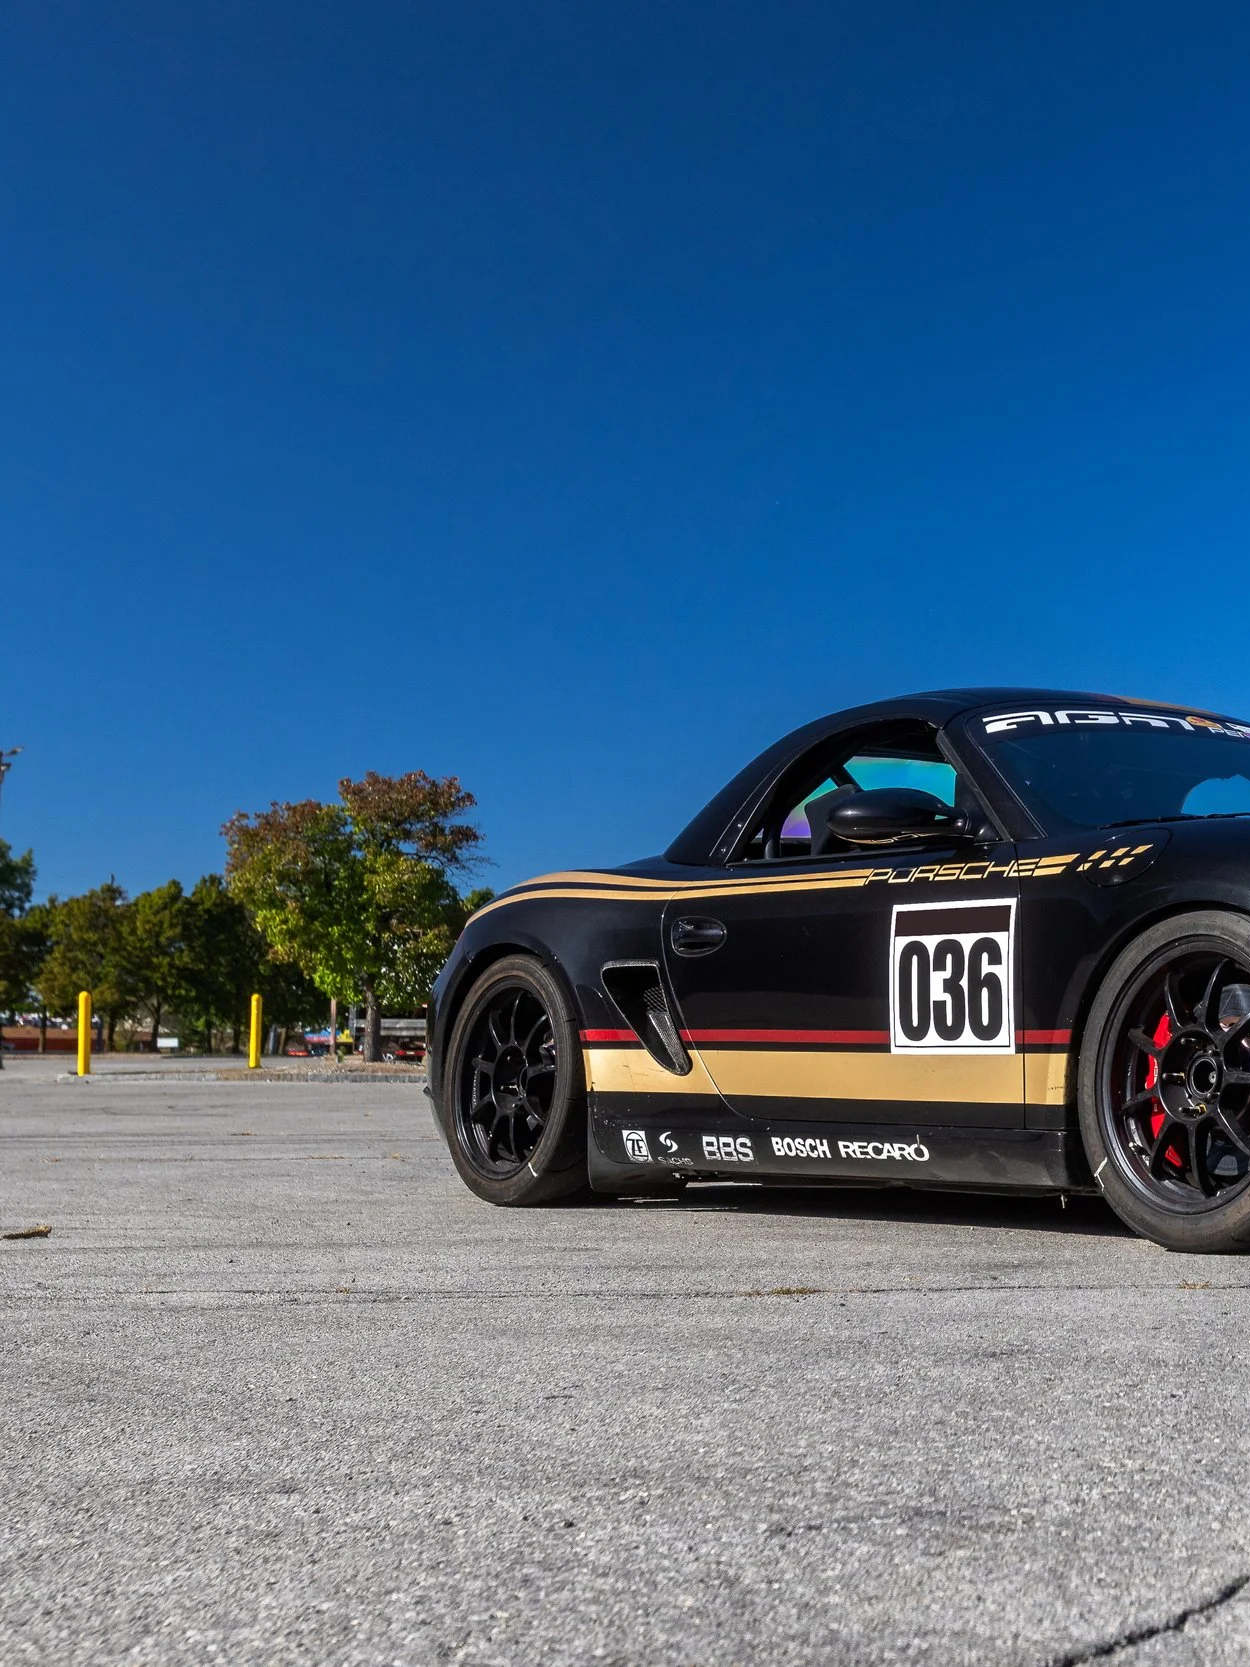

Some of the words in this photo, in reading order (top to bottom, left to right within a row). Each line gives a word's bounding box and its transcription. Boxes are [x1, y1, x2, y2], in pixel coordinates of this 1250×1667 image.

[864, 859, 1037, 885] PORSCHE
[898, 936, 1003, 1042] 036
[702, 1135, 754, 1162] BBS
[771, 1136, 832, 1159] BOSCH
[838, 1140, 930, 1162] RECARO
[657, 1156, 694, 1166] SACHS
